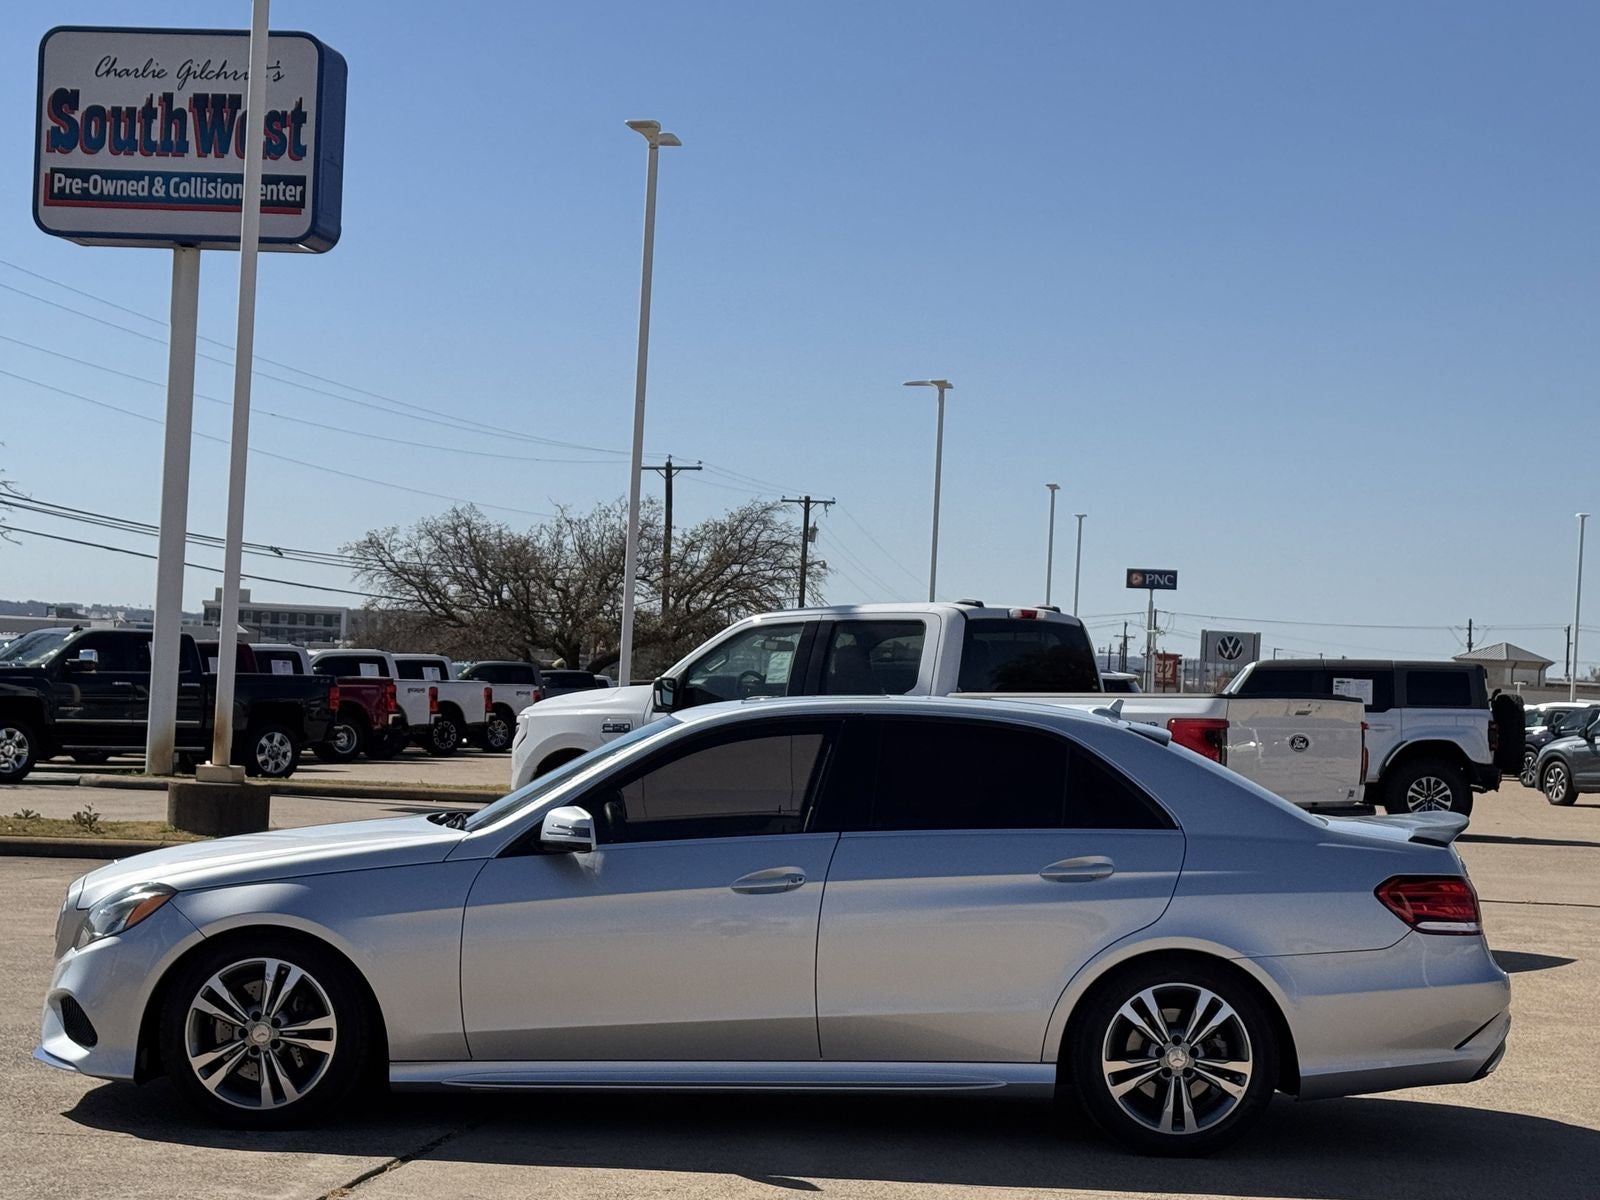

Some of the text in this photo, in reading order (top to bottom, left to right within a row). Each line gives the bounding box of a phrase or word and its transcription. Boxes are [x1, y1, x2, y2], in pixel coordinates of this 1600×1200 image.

[95, 55, 168, 79] Charlie
[53, 173, 304, 202] Pre-Owned & Collision enter
[1144, 573, 1175, 586] PNC
